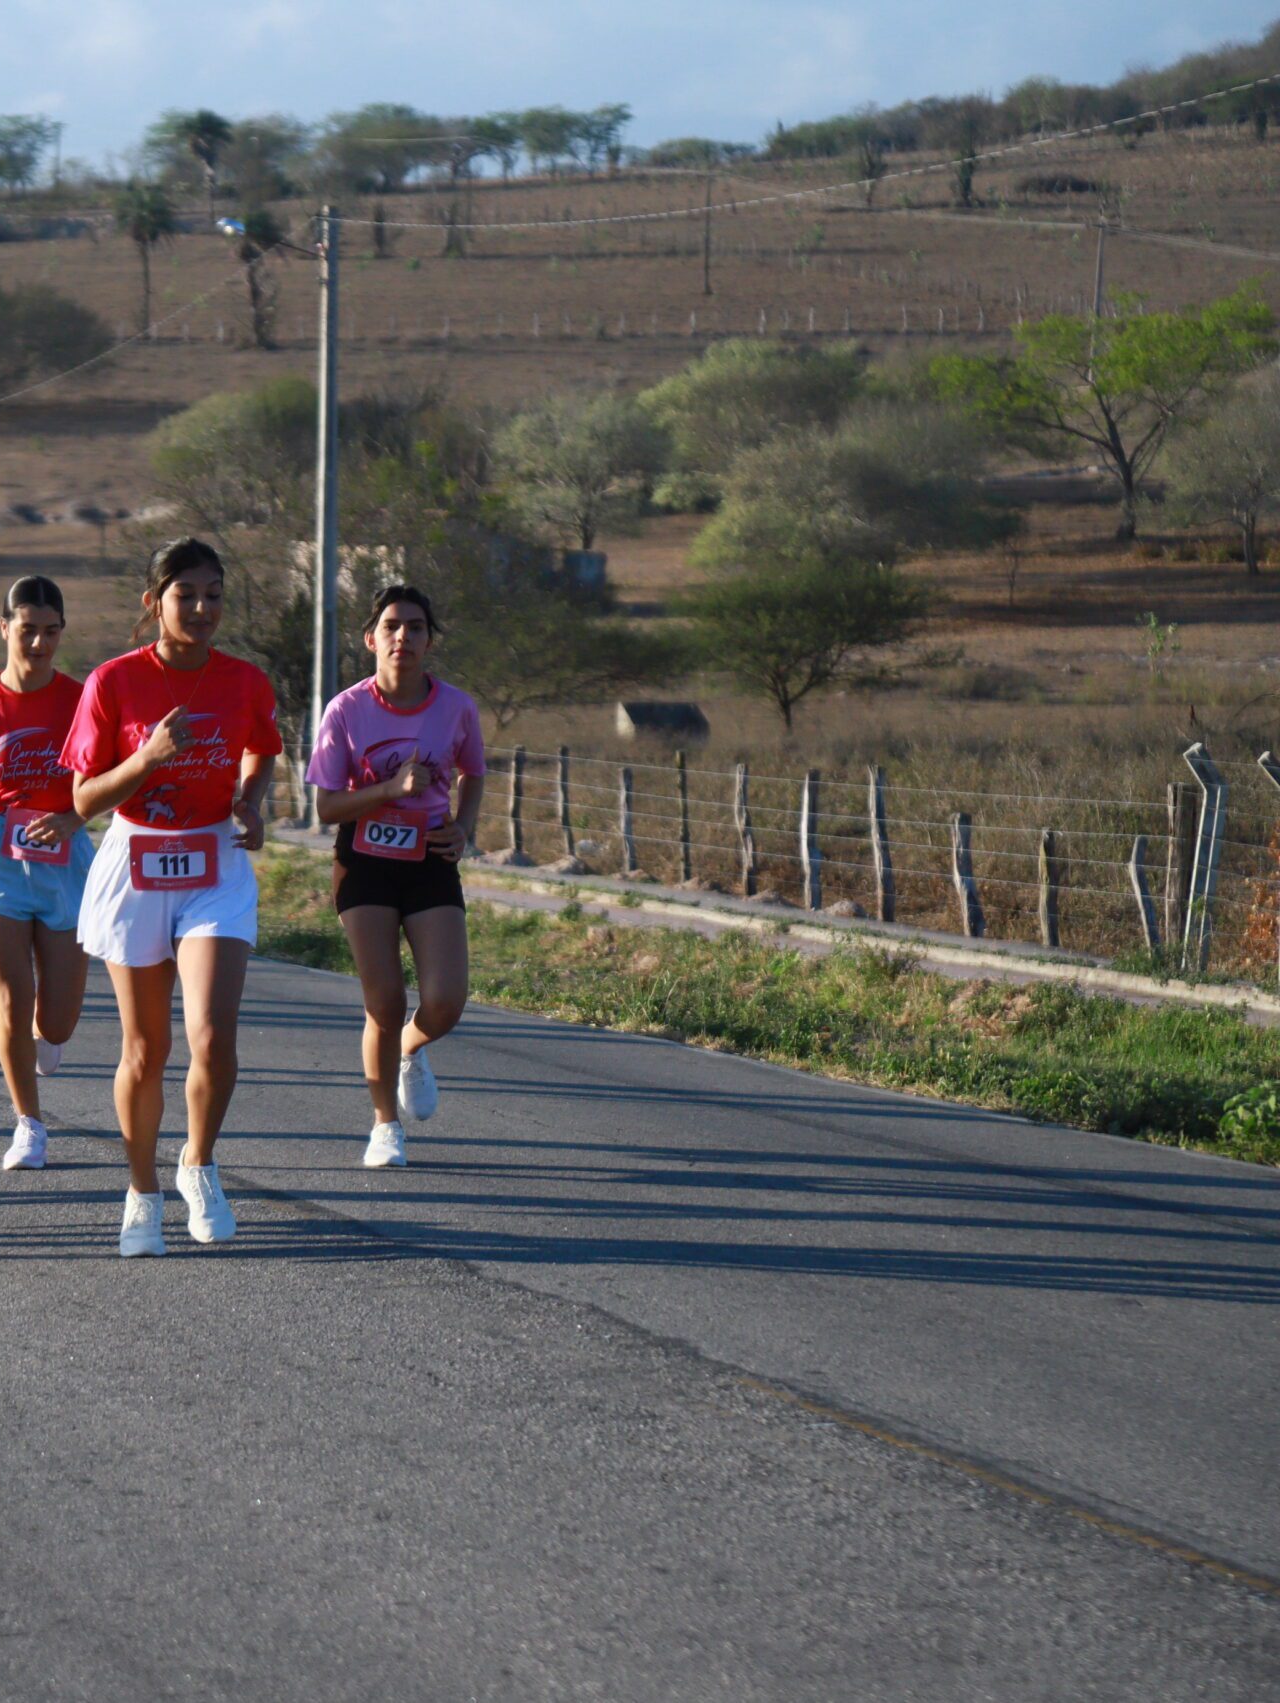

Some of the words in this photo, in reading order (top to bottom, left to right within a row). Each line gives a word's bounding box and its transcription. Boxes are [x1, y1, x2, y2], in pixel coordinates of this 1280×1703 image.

[9, 740, 59, 762] Corrida
[156, 751, 204, 772] utubro
[368, 823, 414, 847] 097
[159, 854, 190, 876] 111
